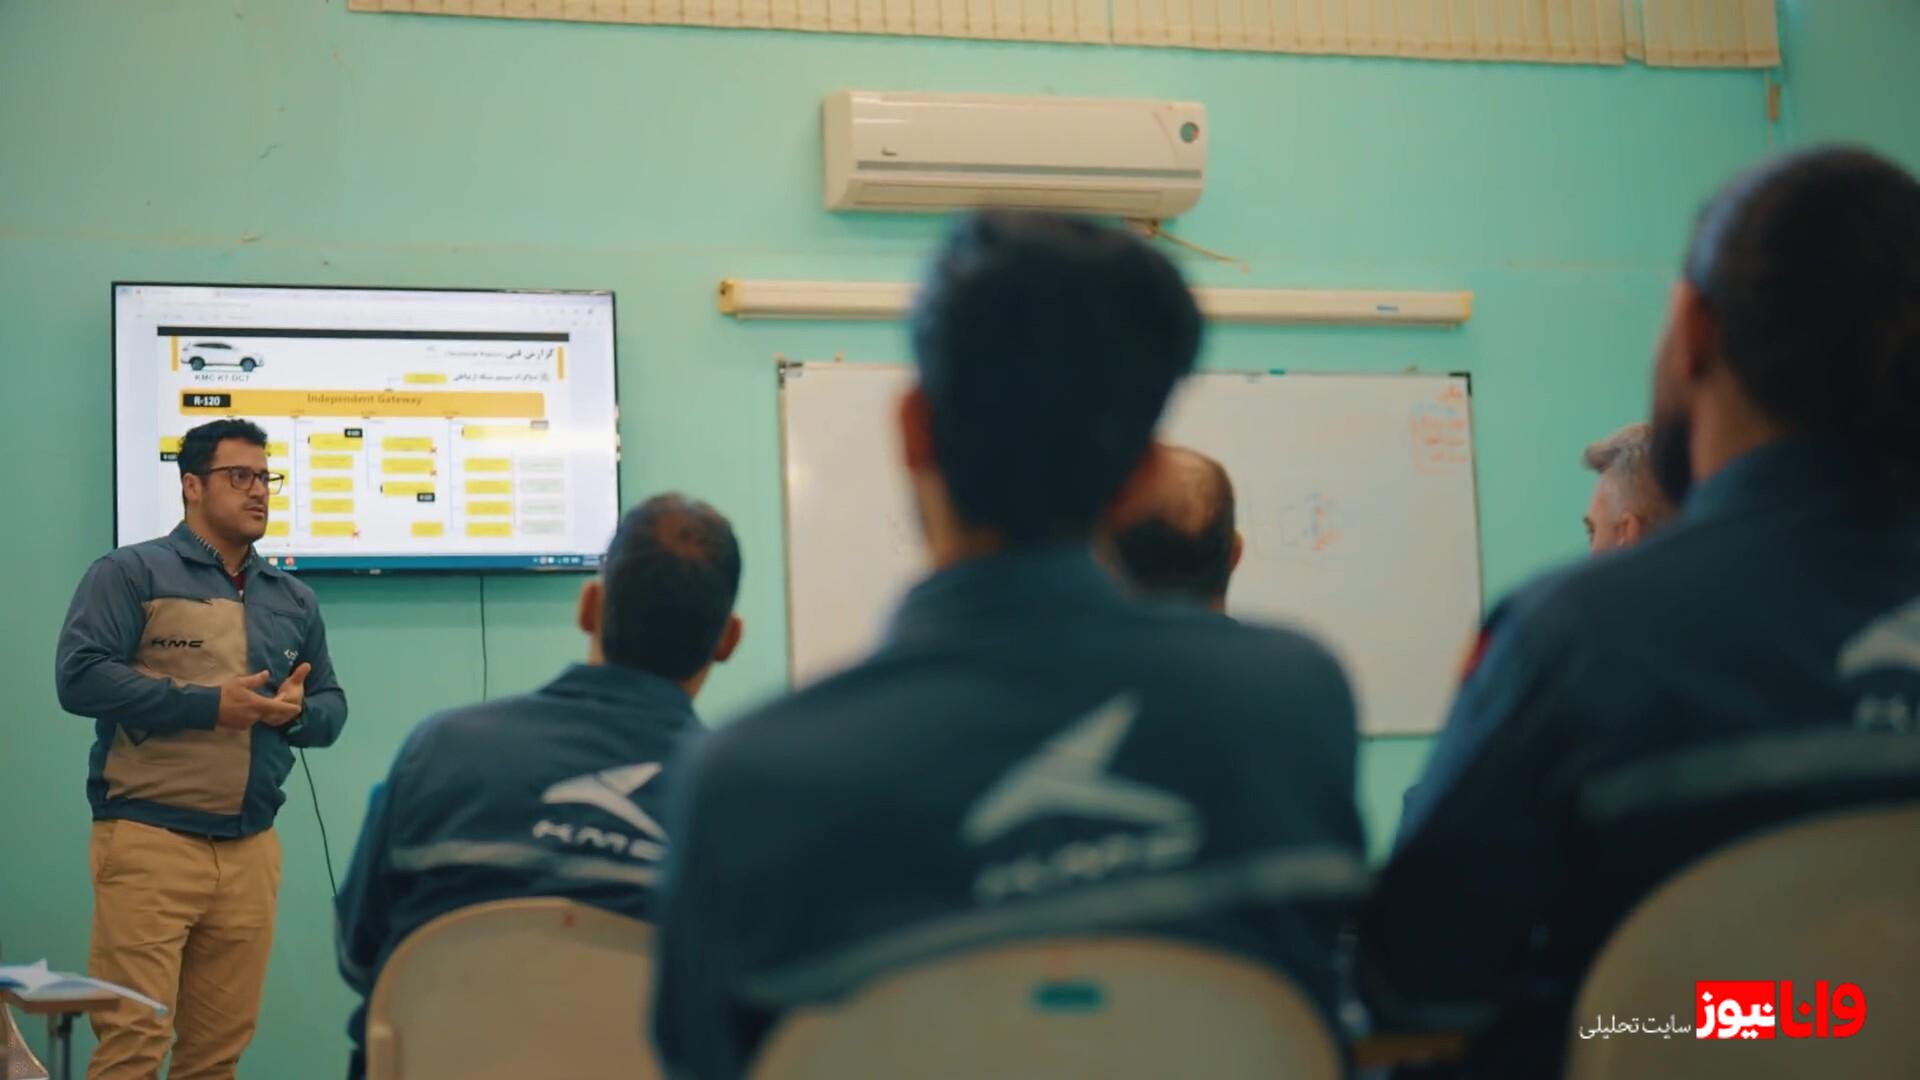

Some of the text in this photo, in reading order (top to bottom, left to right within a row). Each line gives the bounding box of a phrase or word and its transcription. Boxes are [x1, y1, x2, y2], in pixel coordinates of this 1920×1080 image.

[193, 395, 221, 406] R-120
[306, 392, 423, 407] Independent Gateway
[151, 638, 205, 649] KMC
